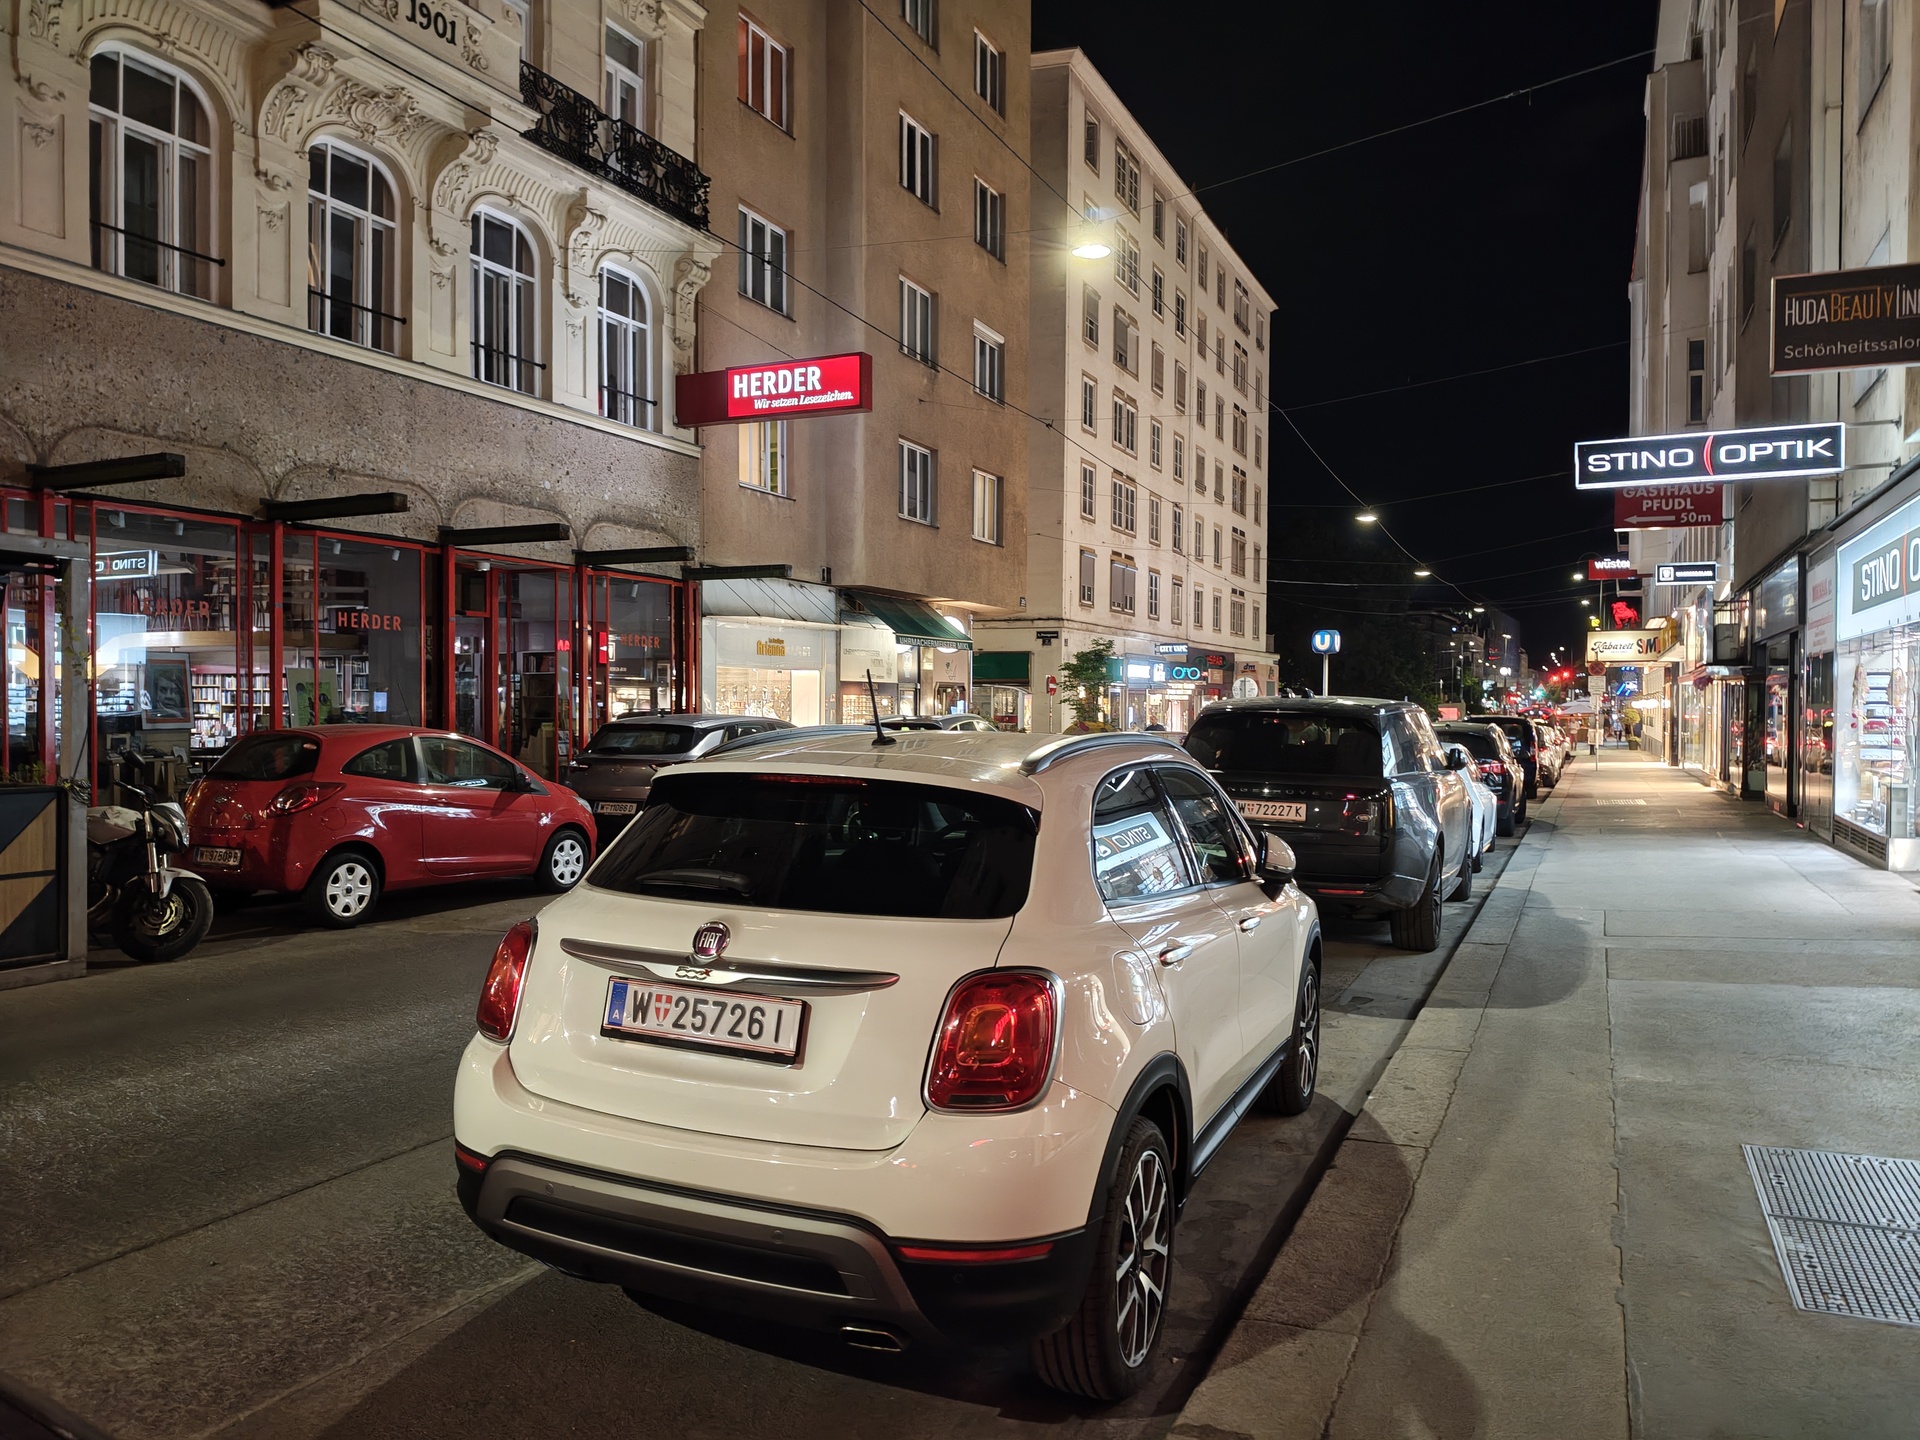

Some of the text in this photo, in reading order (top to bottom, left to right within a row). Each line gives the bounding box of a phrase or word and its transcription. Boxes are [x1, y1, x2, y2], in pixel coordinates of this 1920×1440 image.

[405, 0, 457, 46] 1901
[733, 365, 822, 398] HERDER
[754, 389, 854, 410] Wir setzen Lesezeichen.
[1587, 438, 1834, 473] STINO OPTIK
[1622, 483, 1716, 499] GASTHAUS
[1642, 497, 1694, 511] PFUDL
[1680, 512, 1712, 524] 50m
[1861, 548, 1901, 602] STINO
[337, 611, 402, 632] HERDER
[620, 633, 661, 649] HERDER
[899, 637, 957, 649] UHRMACHERMEISTER
[1315, 634, 1331, 651] U
[1256, 803, 1293, 817] 72227
[698, 931, 722, 949] FIAT
[632, 989, 653, 1025] W
[671, 995, 766, 1041] 25726
